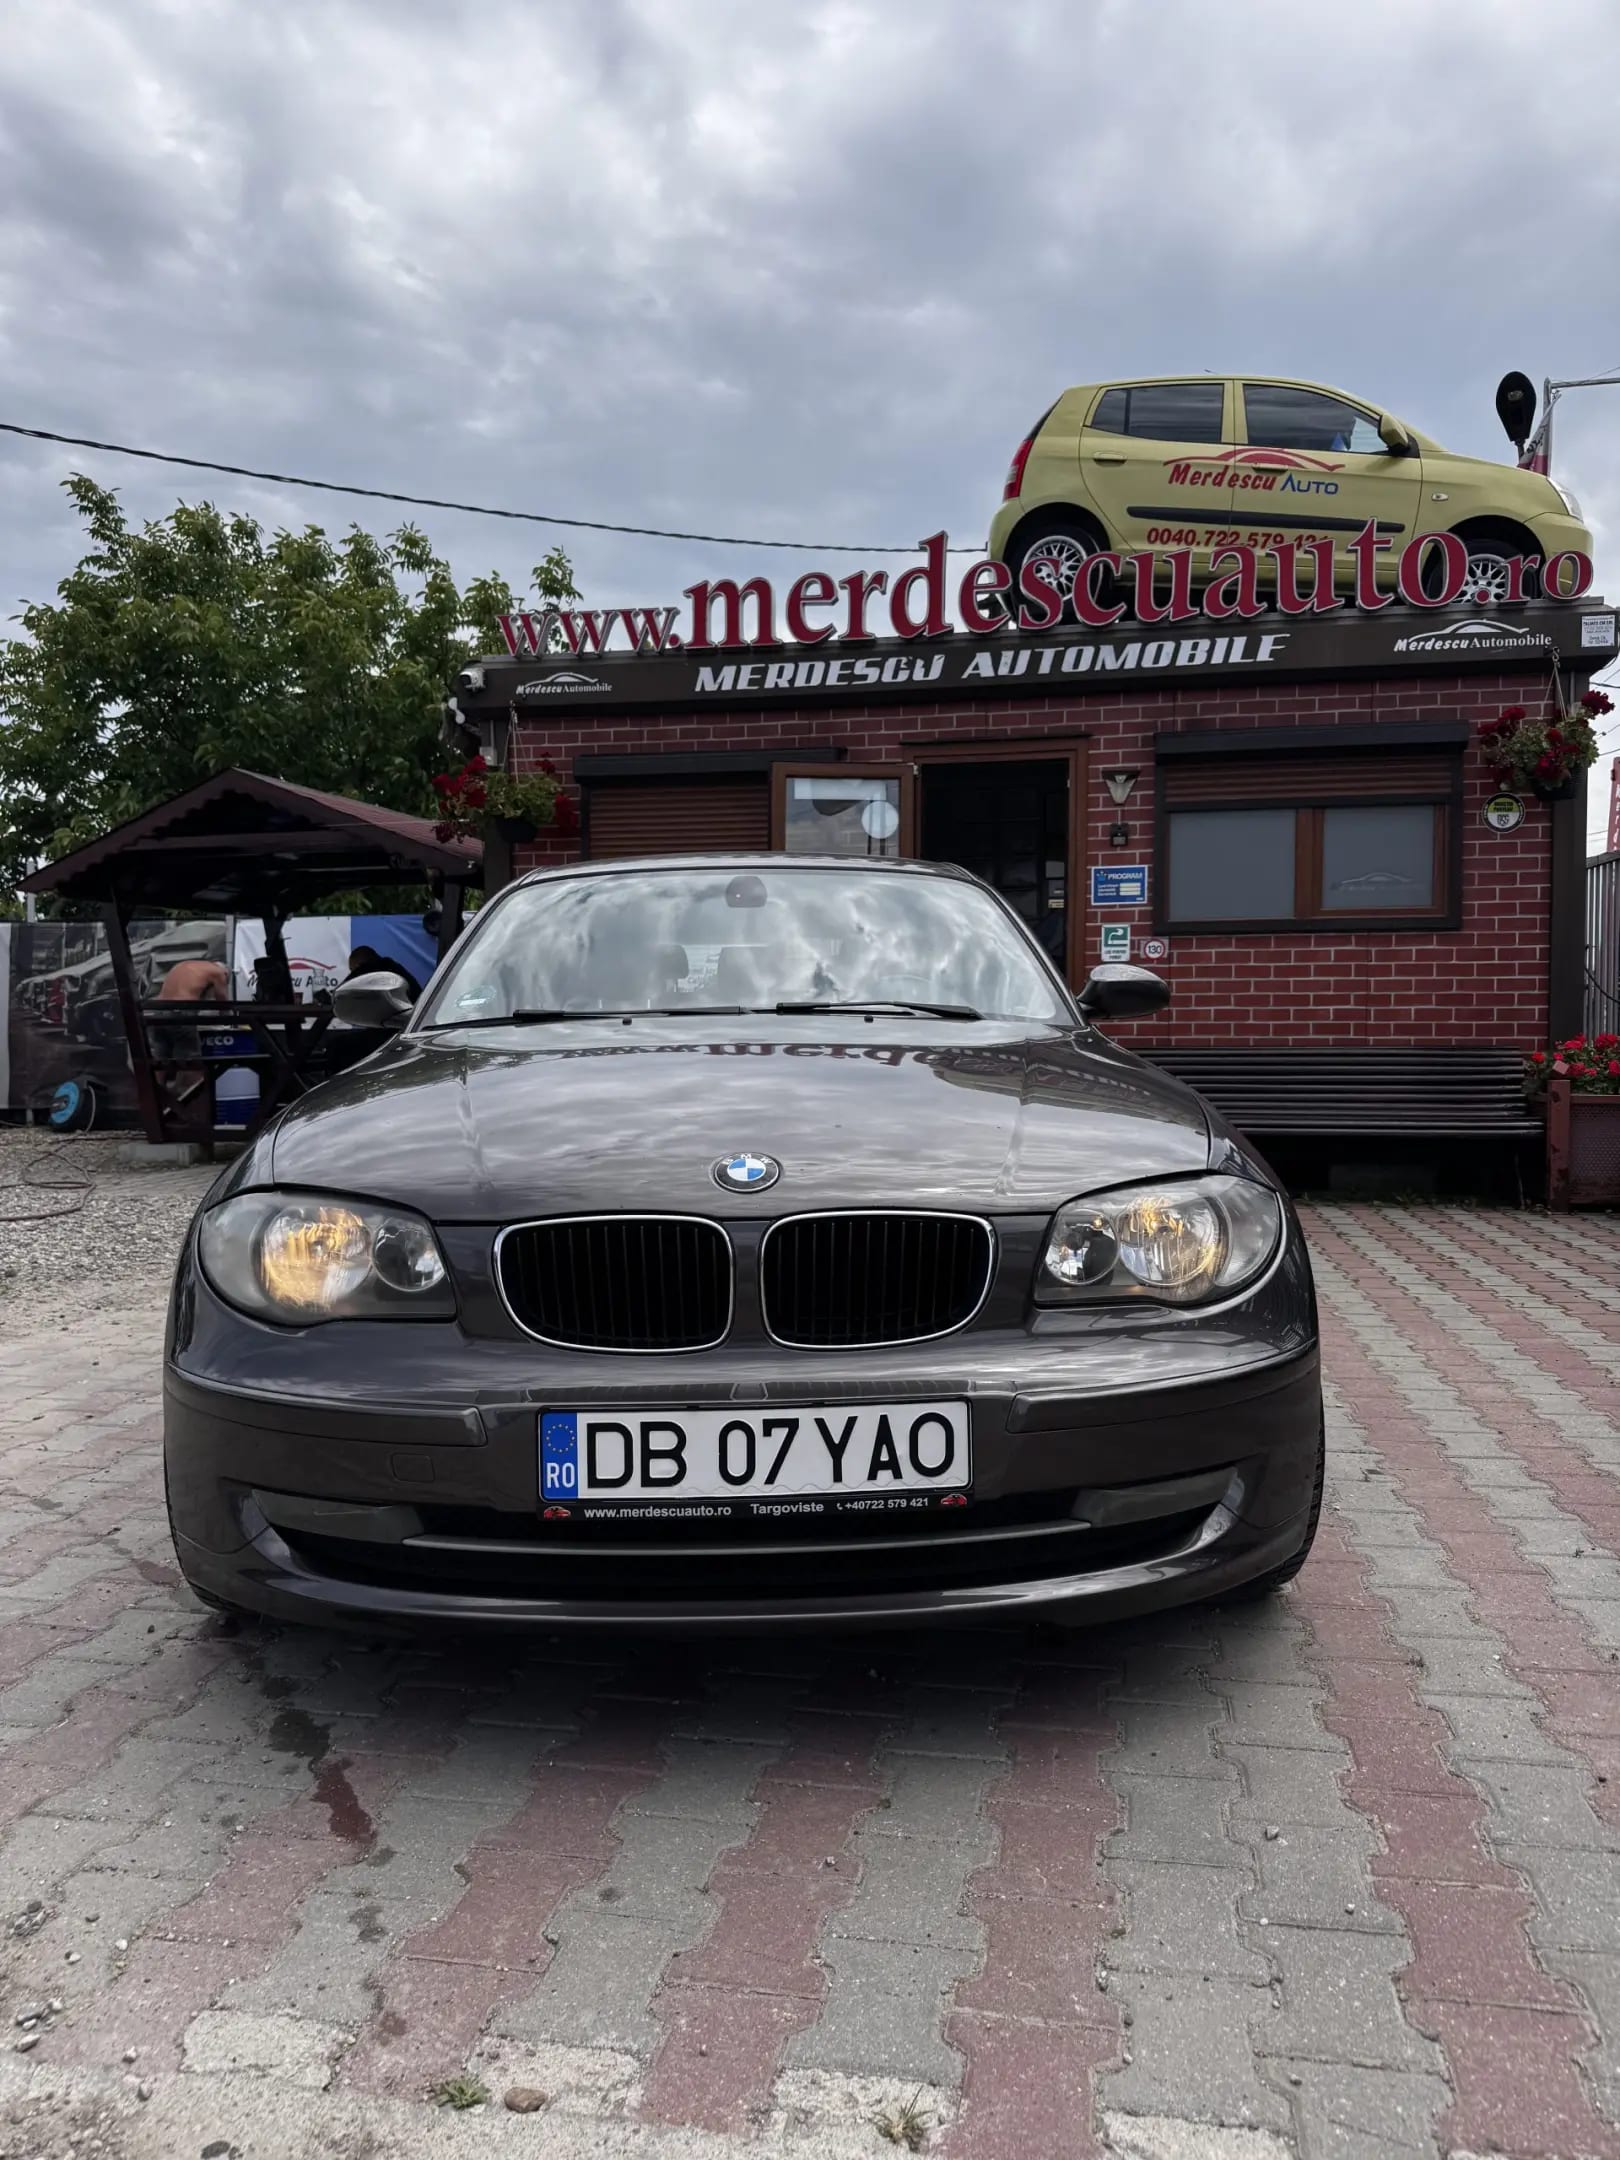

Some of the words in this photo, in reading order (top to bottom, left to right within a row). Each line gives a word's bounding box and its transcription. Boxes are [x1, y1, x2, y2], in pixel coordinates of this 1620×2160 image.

[1168, 463, 1278, 491] Merdescu
[497, 517, 1594, 658] www.merdescuauto.ro
[695, 655, 945, 693] MERDESCU
[961, 632, 1291, 680] AUTOMOBILE
[1147, 944, 1162, 955] 130
[586, 1420, 688, 1489] DB
[718, 1418, 800, 1486] 07
[814, 1411, 956, 1484] YAO
[546, 1462, 576, 1489] RO
[584, 1506, 732, 1519] www.merdescuauto.ro
[750, 1502, 825, 1517] Targoviste
[887, 1499, 907, 1508] 579
[910, 1498, 929, 1507] 421
